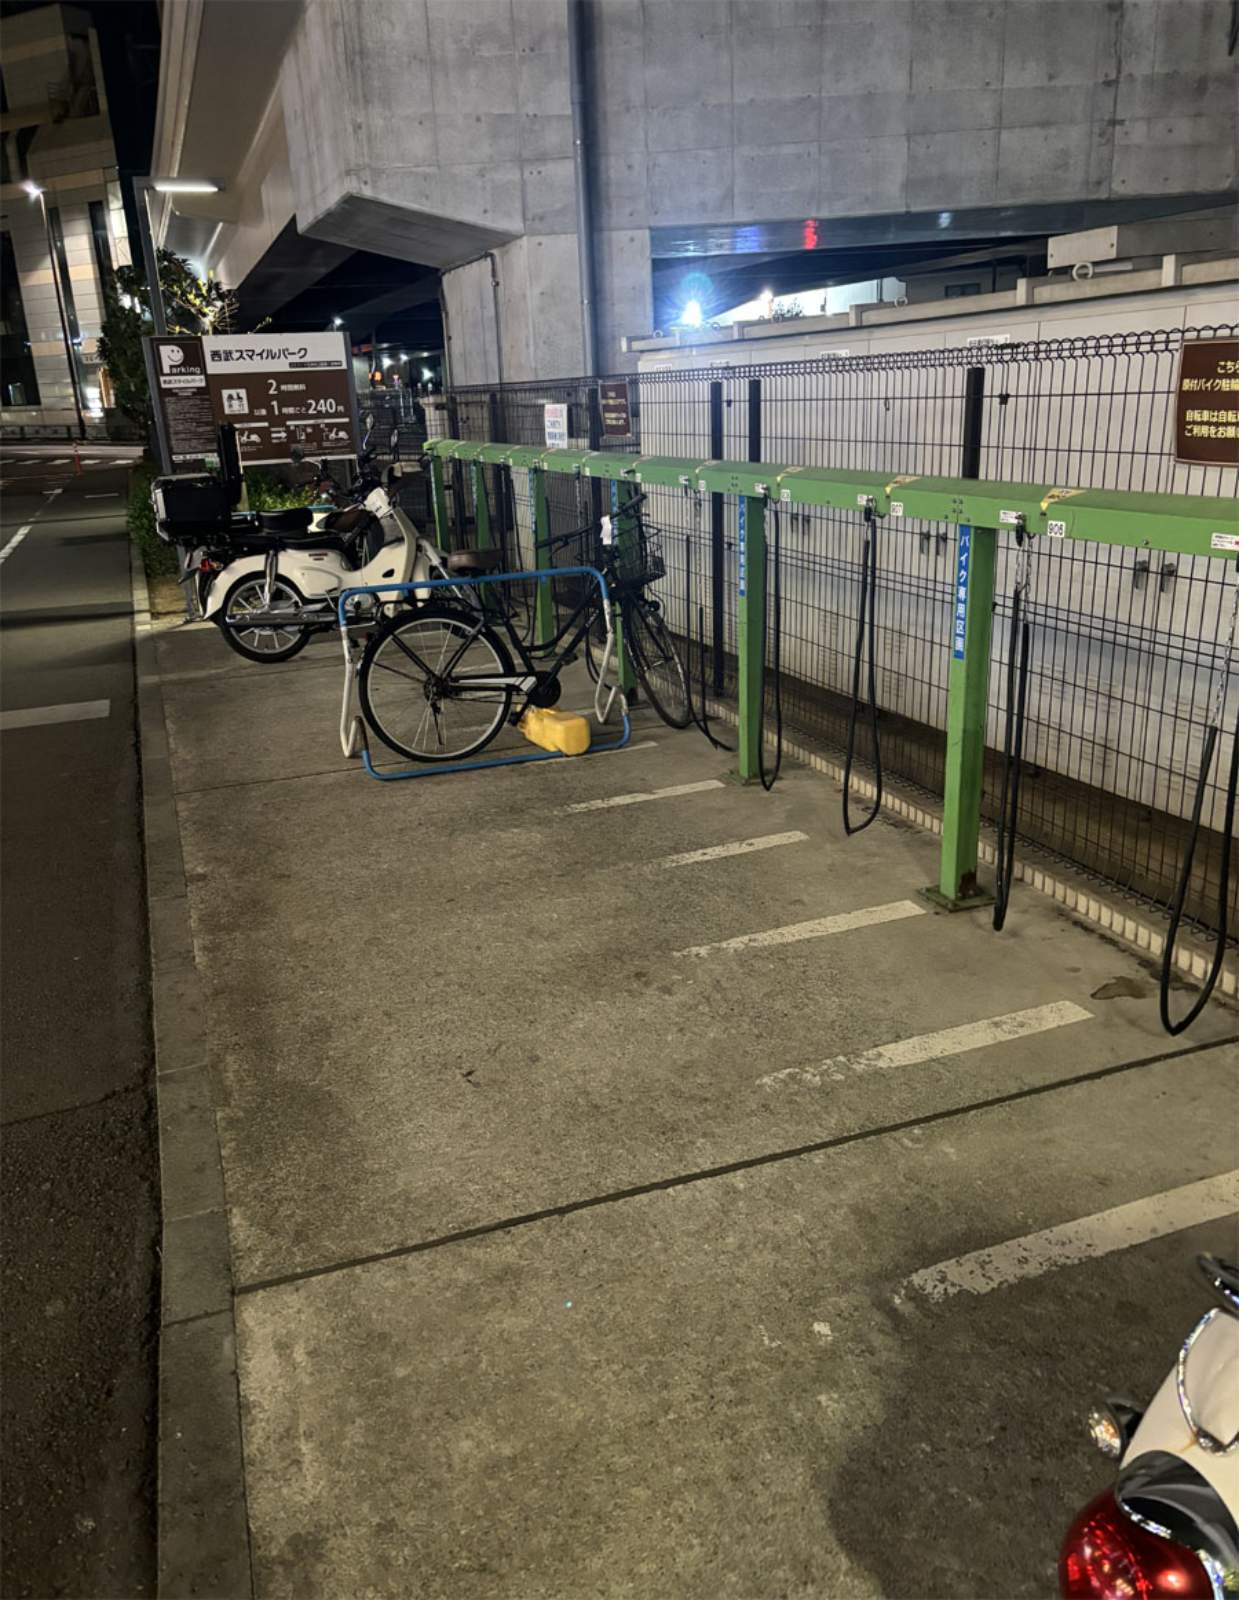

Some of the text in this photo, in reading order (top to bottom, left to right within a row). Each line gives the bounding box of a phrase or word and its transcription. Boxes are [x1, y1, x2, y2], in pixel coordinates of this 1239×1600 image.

[159, 345, 201, 374] Parking
[210, 347, 308, 362] 西武スマイルパーク
[267, 379, 278, 395] 2
[307, 399, 336, 414] 240
[1186, 410, 1239, 422] 自転車は自転
[1185, 425, 1239, 438] ご利用をお願
